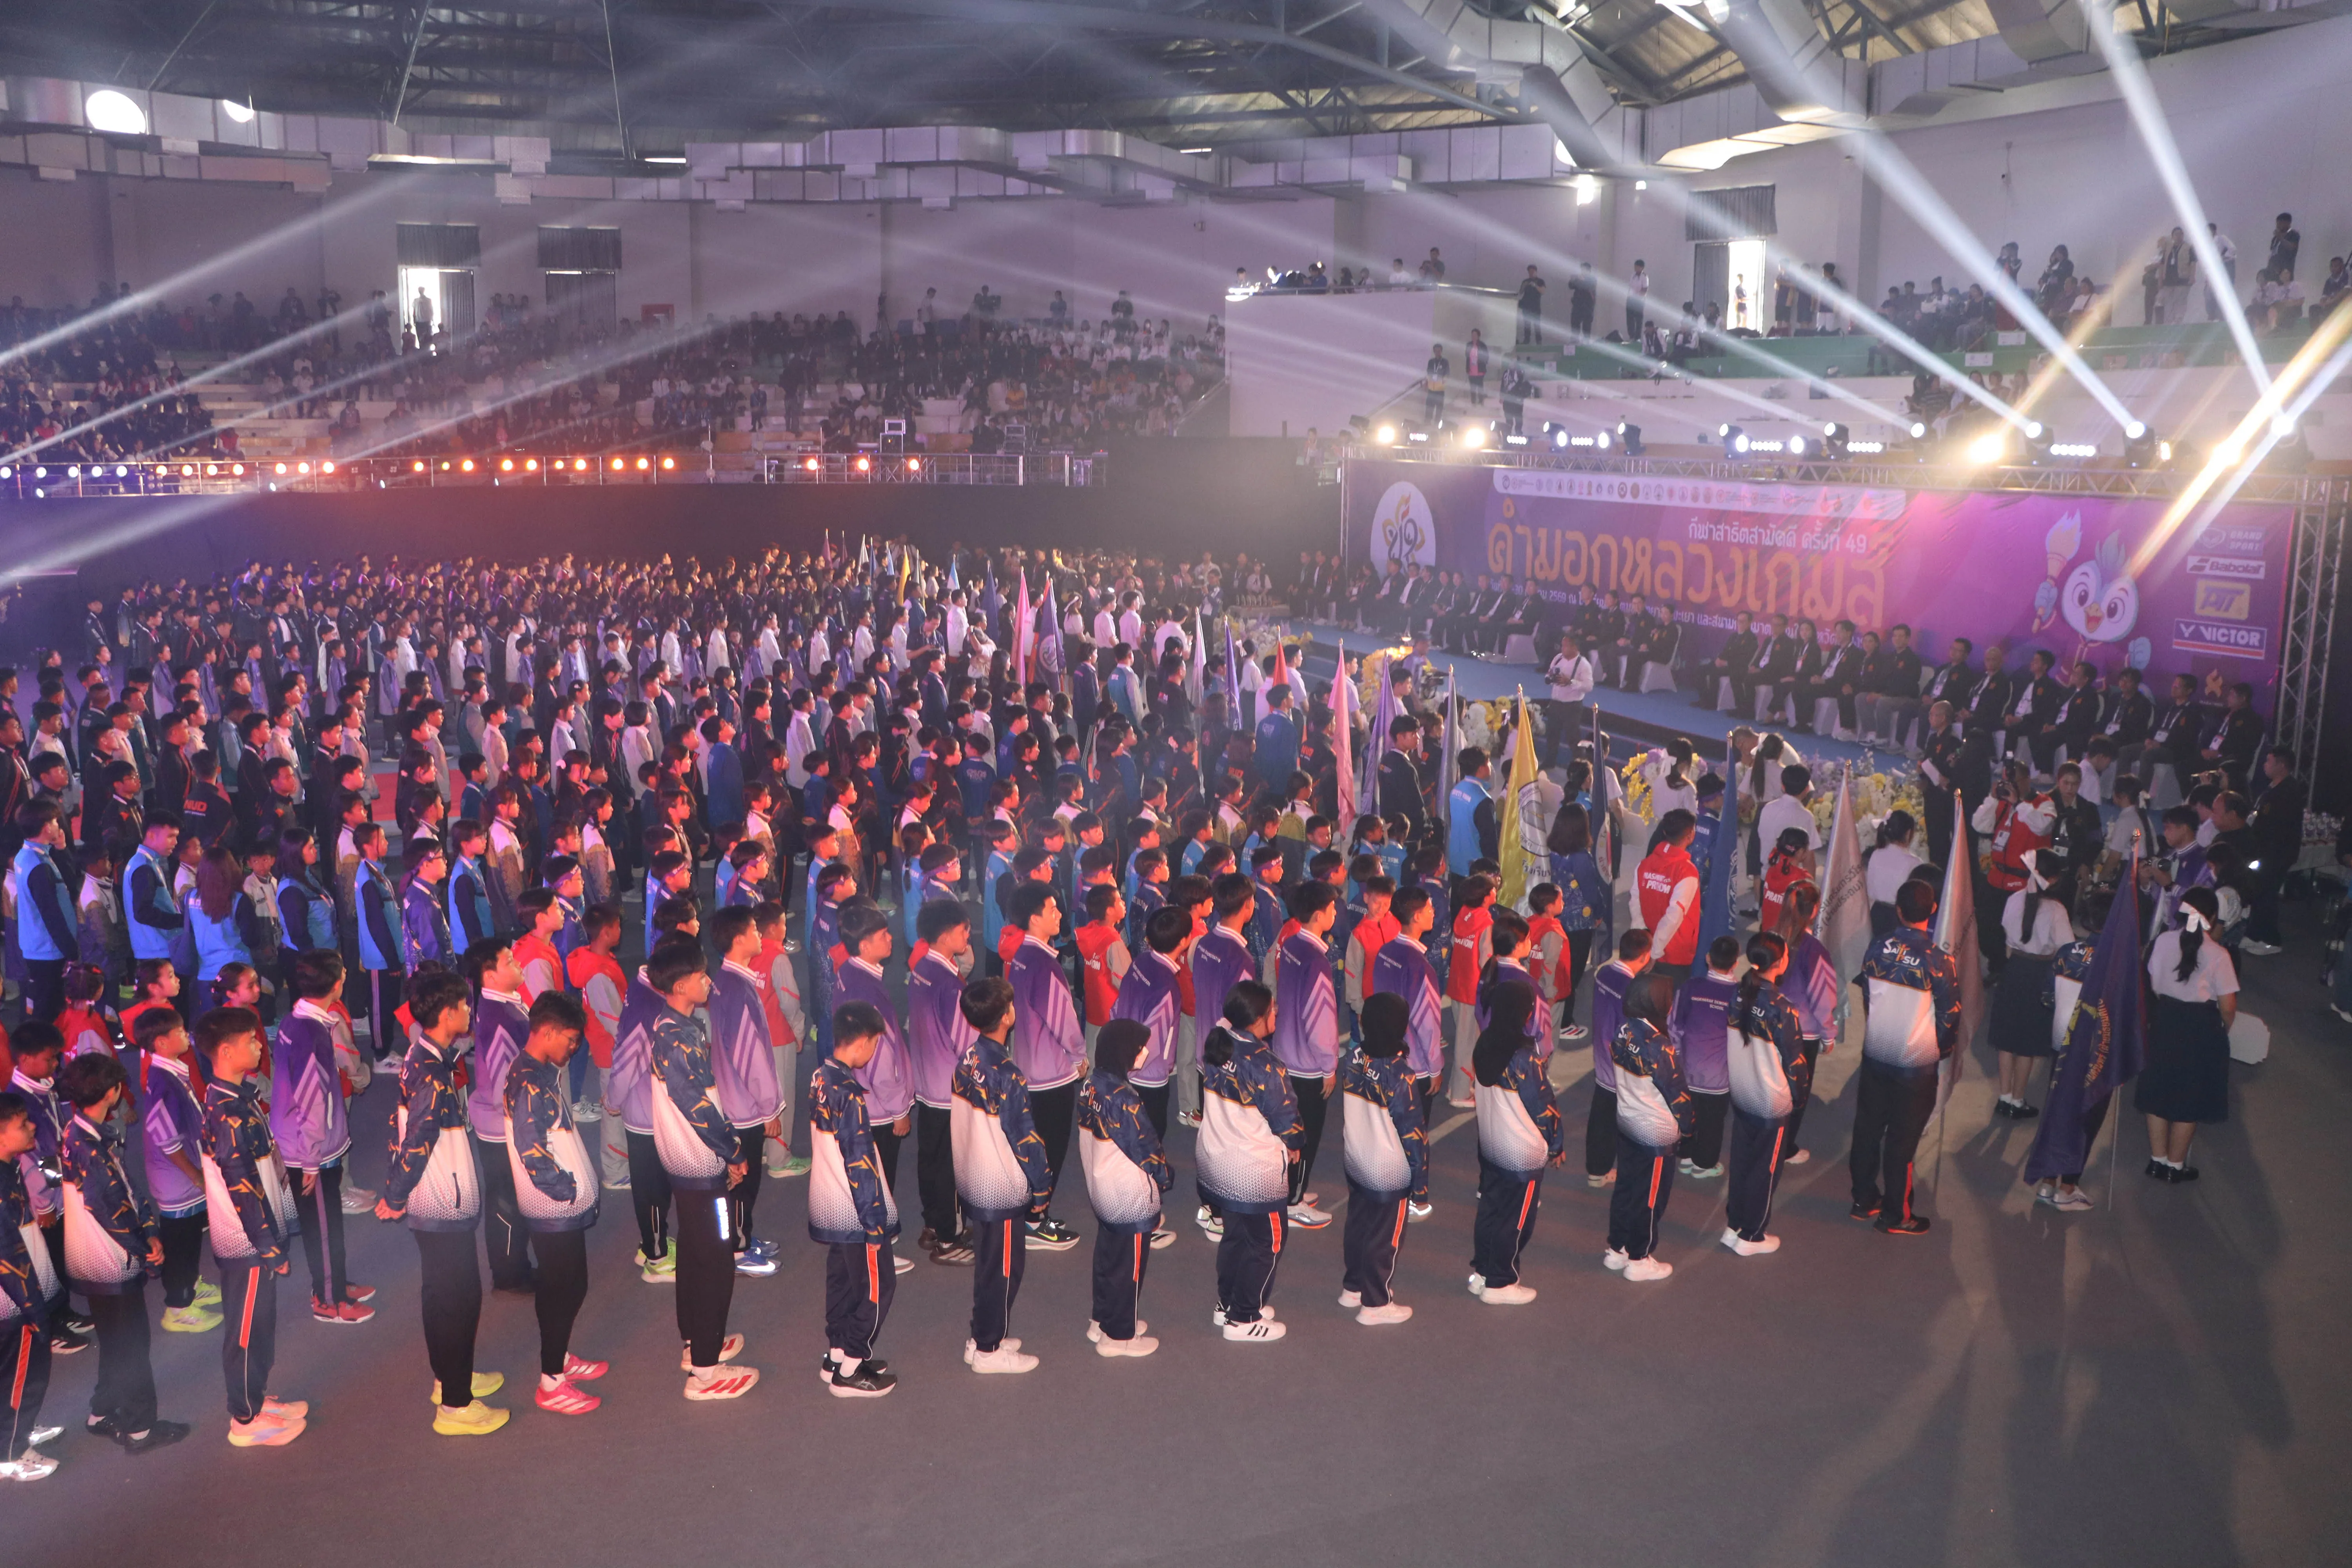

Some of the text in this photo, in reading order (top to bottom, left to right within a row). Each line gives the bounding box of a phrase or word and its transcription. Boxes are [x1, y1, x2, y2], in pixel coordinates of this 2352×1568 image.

[2230, 530, 2262, 541] GRAND
[1846, 534, 1867, 554] 49
[2230, 543, 2259, 551] SPORT
[2209, 561, 2264, 574] Babolat
[2200, 626, 2261, 646] VICTOR
[183, 799, 208, 812] NUD
[1751, 1006, 1765, 1017] SU
